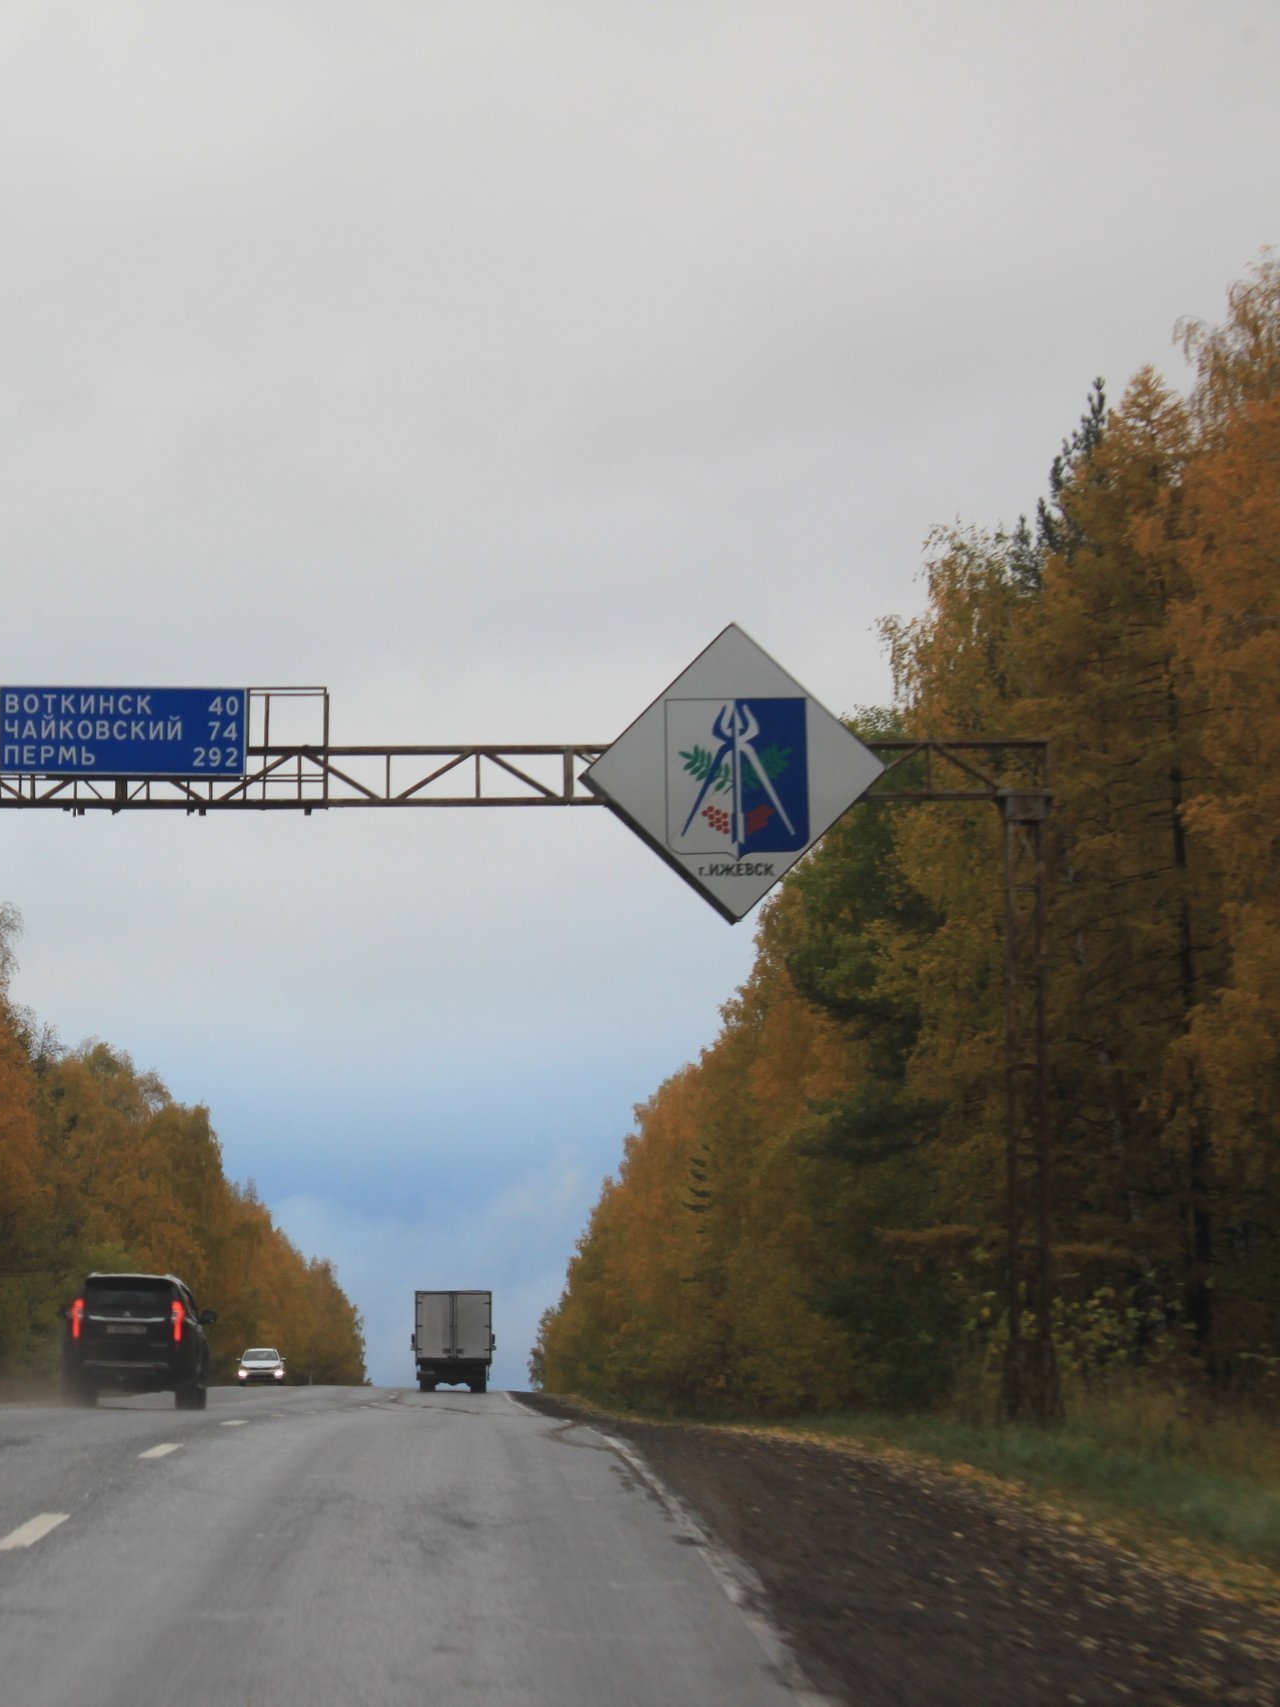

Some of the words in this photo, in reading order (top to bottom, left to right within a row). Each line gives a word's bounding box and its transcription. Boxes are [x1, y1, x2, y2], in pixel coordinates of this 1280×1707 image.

[4, 694, 152, 715] ВОТКИНСК
[208, 696, 239, 716] 40
[4, 715, 183, 741] ЧАЙКОВСКИЙ
[208, 721, 238, 742] 74
[3, 745, 96, 766] ПЕРМЬ
[192, 747, 238, 767] 292
